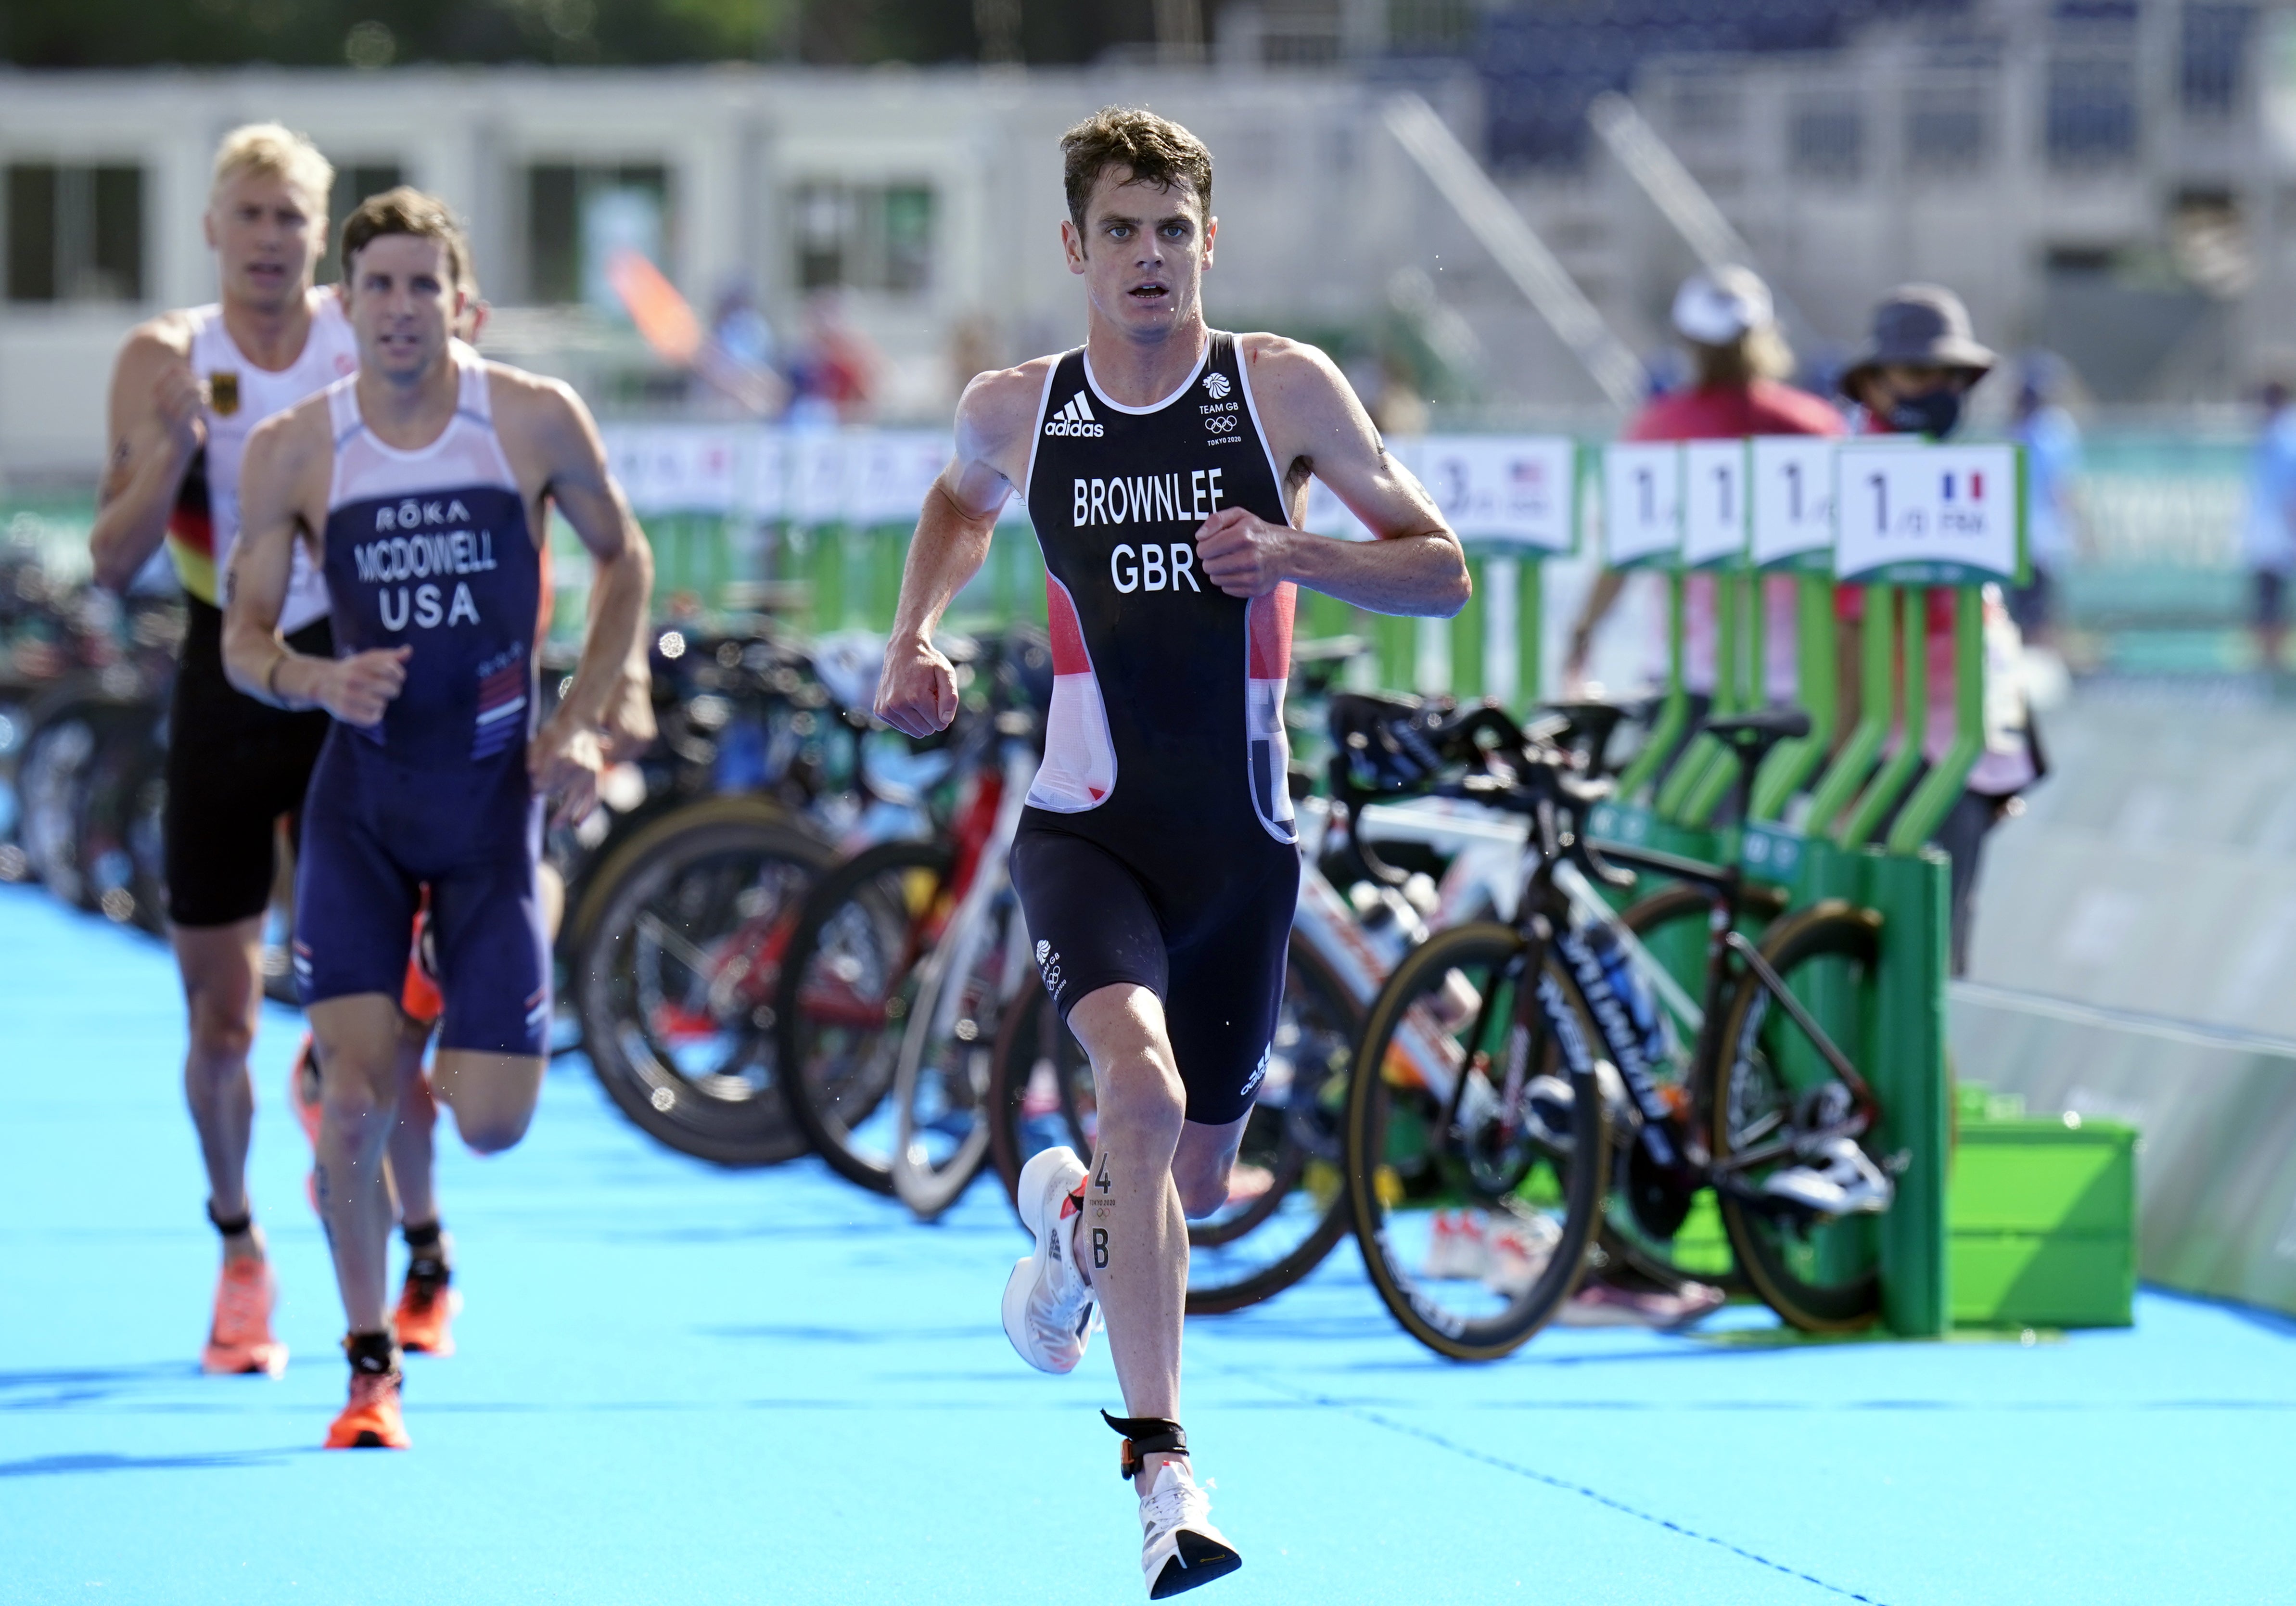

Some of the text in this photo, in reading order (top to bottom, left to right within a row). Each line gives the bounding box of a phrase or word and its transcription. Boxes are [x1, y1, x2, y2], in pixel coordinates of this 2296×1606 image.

[1045, 419, 1104, 437] adidas
[1199, 402, 1239, 414] TEAM GB
[1207, 437, 1226, 446] TOKYO
[1073, 468, 1224, 527] BROWNLEE
[354, 529, 497, 583] MCDOWELL
[1111, 543, 1201, 594] GBR
[379, 581, 481, 632] USA
[1049, 952, 1060, 965] GB
[1058, 979, 1067, 992] 2020
[1094, 1152, 1111, 1195] 4
[1092, 1227, 1109, 1269] B
